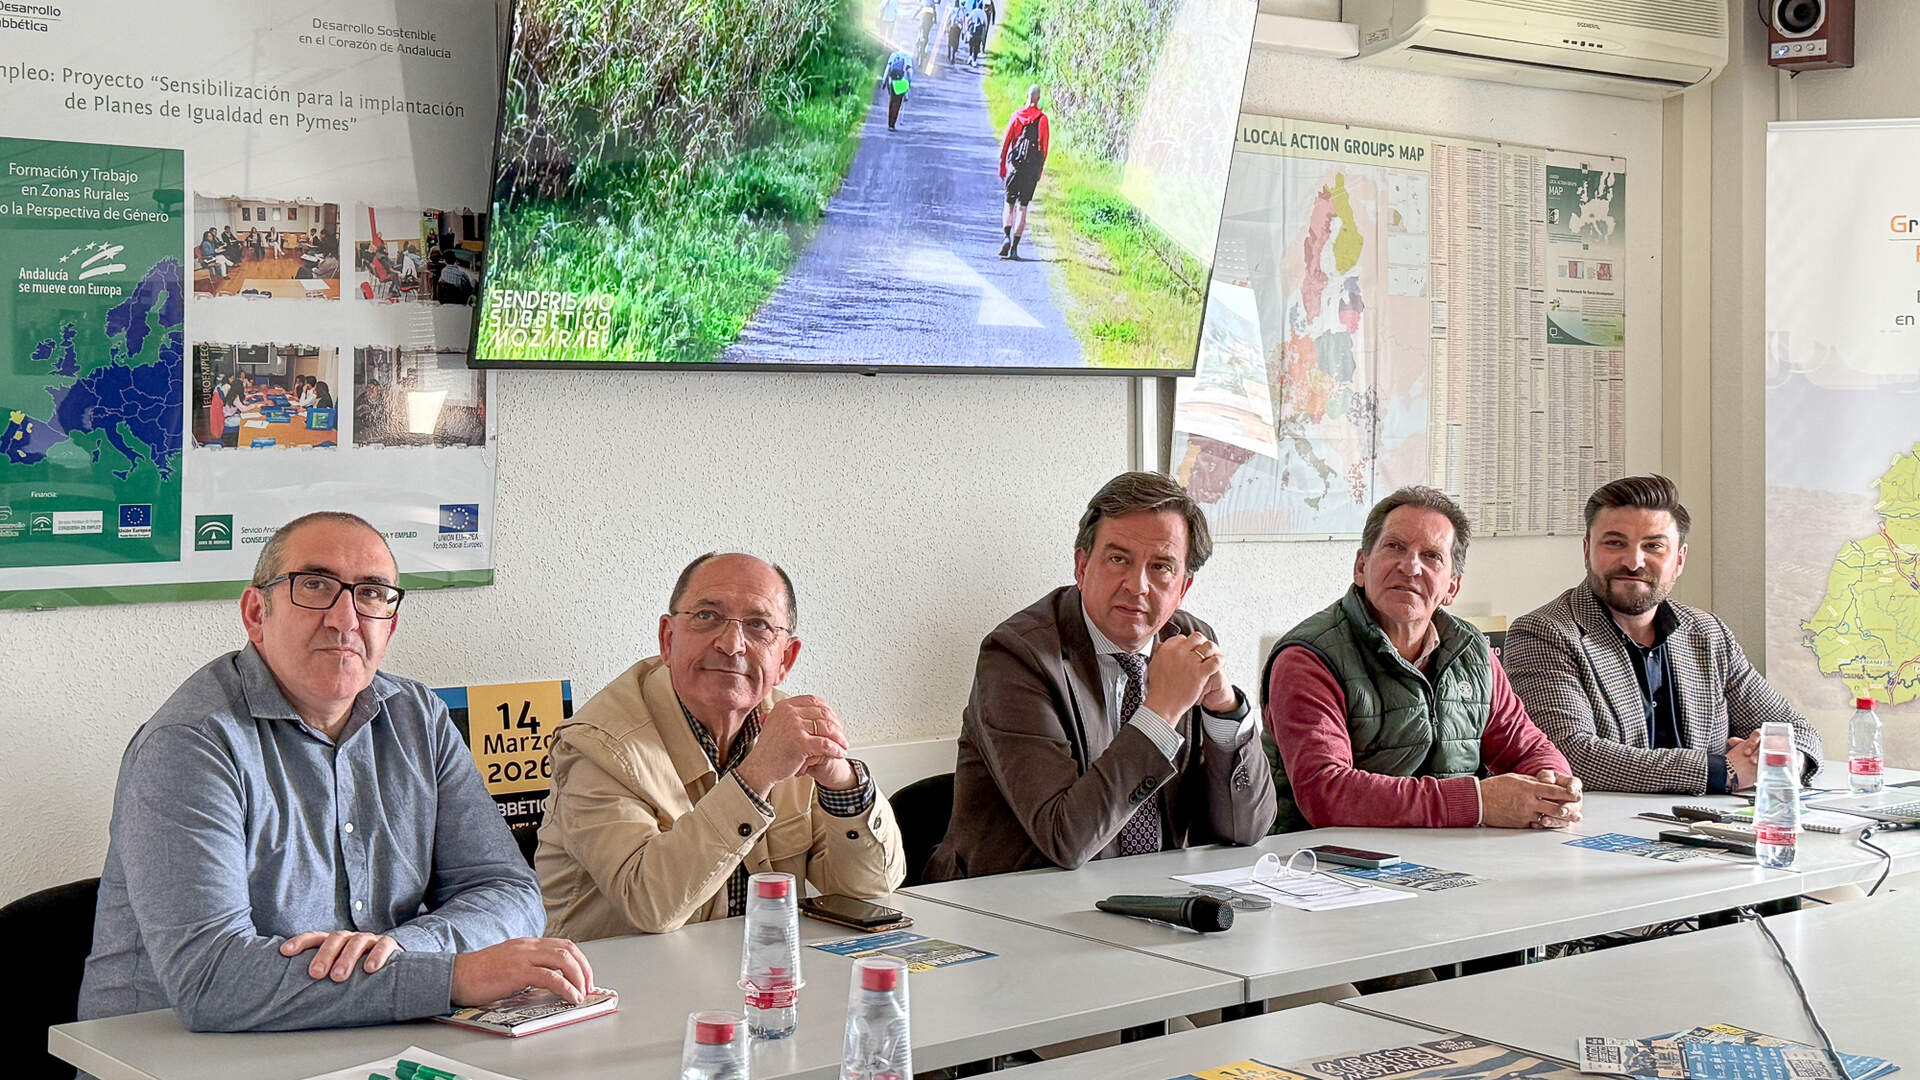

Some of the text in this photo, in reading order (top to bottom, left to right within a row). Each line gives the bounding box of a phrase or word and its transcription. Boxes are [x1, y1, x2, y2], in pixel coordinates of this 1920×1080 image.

[313, 18, 436, 42] Desarrollo Sostenible
[299, 35, 451, 59] en el Corazón de Andalucía
[63, 68, 144, 90] Proyecto
[297, 92, 333, 107] para
[340, 91, 353, 108] la
[360, 94, 464, 117] implantación
[65, 93, 86, 110] de
[95, 95, 153, 115] Planes
[160, 101, 181, 118] de
[188, 104, 262, 124] Igualdad
[269, 113, 288, 126] en
[1243, 127, 1425, 162] LOCAL ACTION GROUPS MAP
[9, 163, 138, 185] Formación y Trabajo
[21, 184, 130, 201] en Zonas Rurales
[12, 201, 23, 215] la
[27, 203, 100, 221] Perspectiva
[104, 208, 119, 220] de
[123, 208, 169, 222] Género
[19, 267, 69, 281] Andalucía
[19, 283, 122, 298] se mueve con Europa
[491, 290, 614, 311] SENDERISMO
[1895, 315, 1915, 326] en
[486, 328, 609, 348] MOZARABE
[496, 700, 541, 735] 14
[488, 755, 552, 784] 2026
